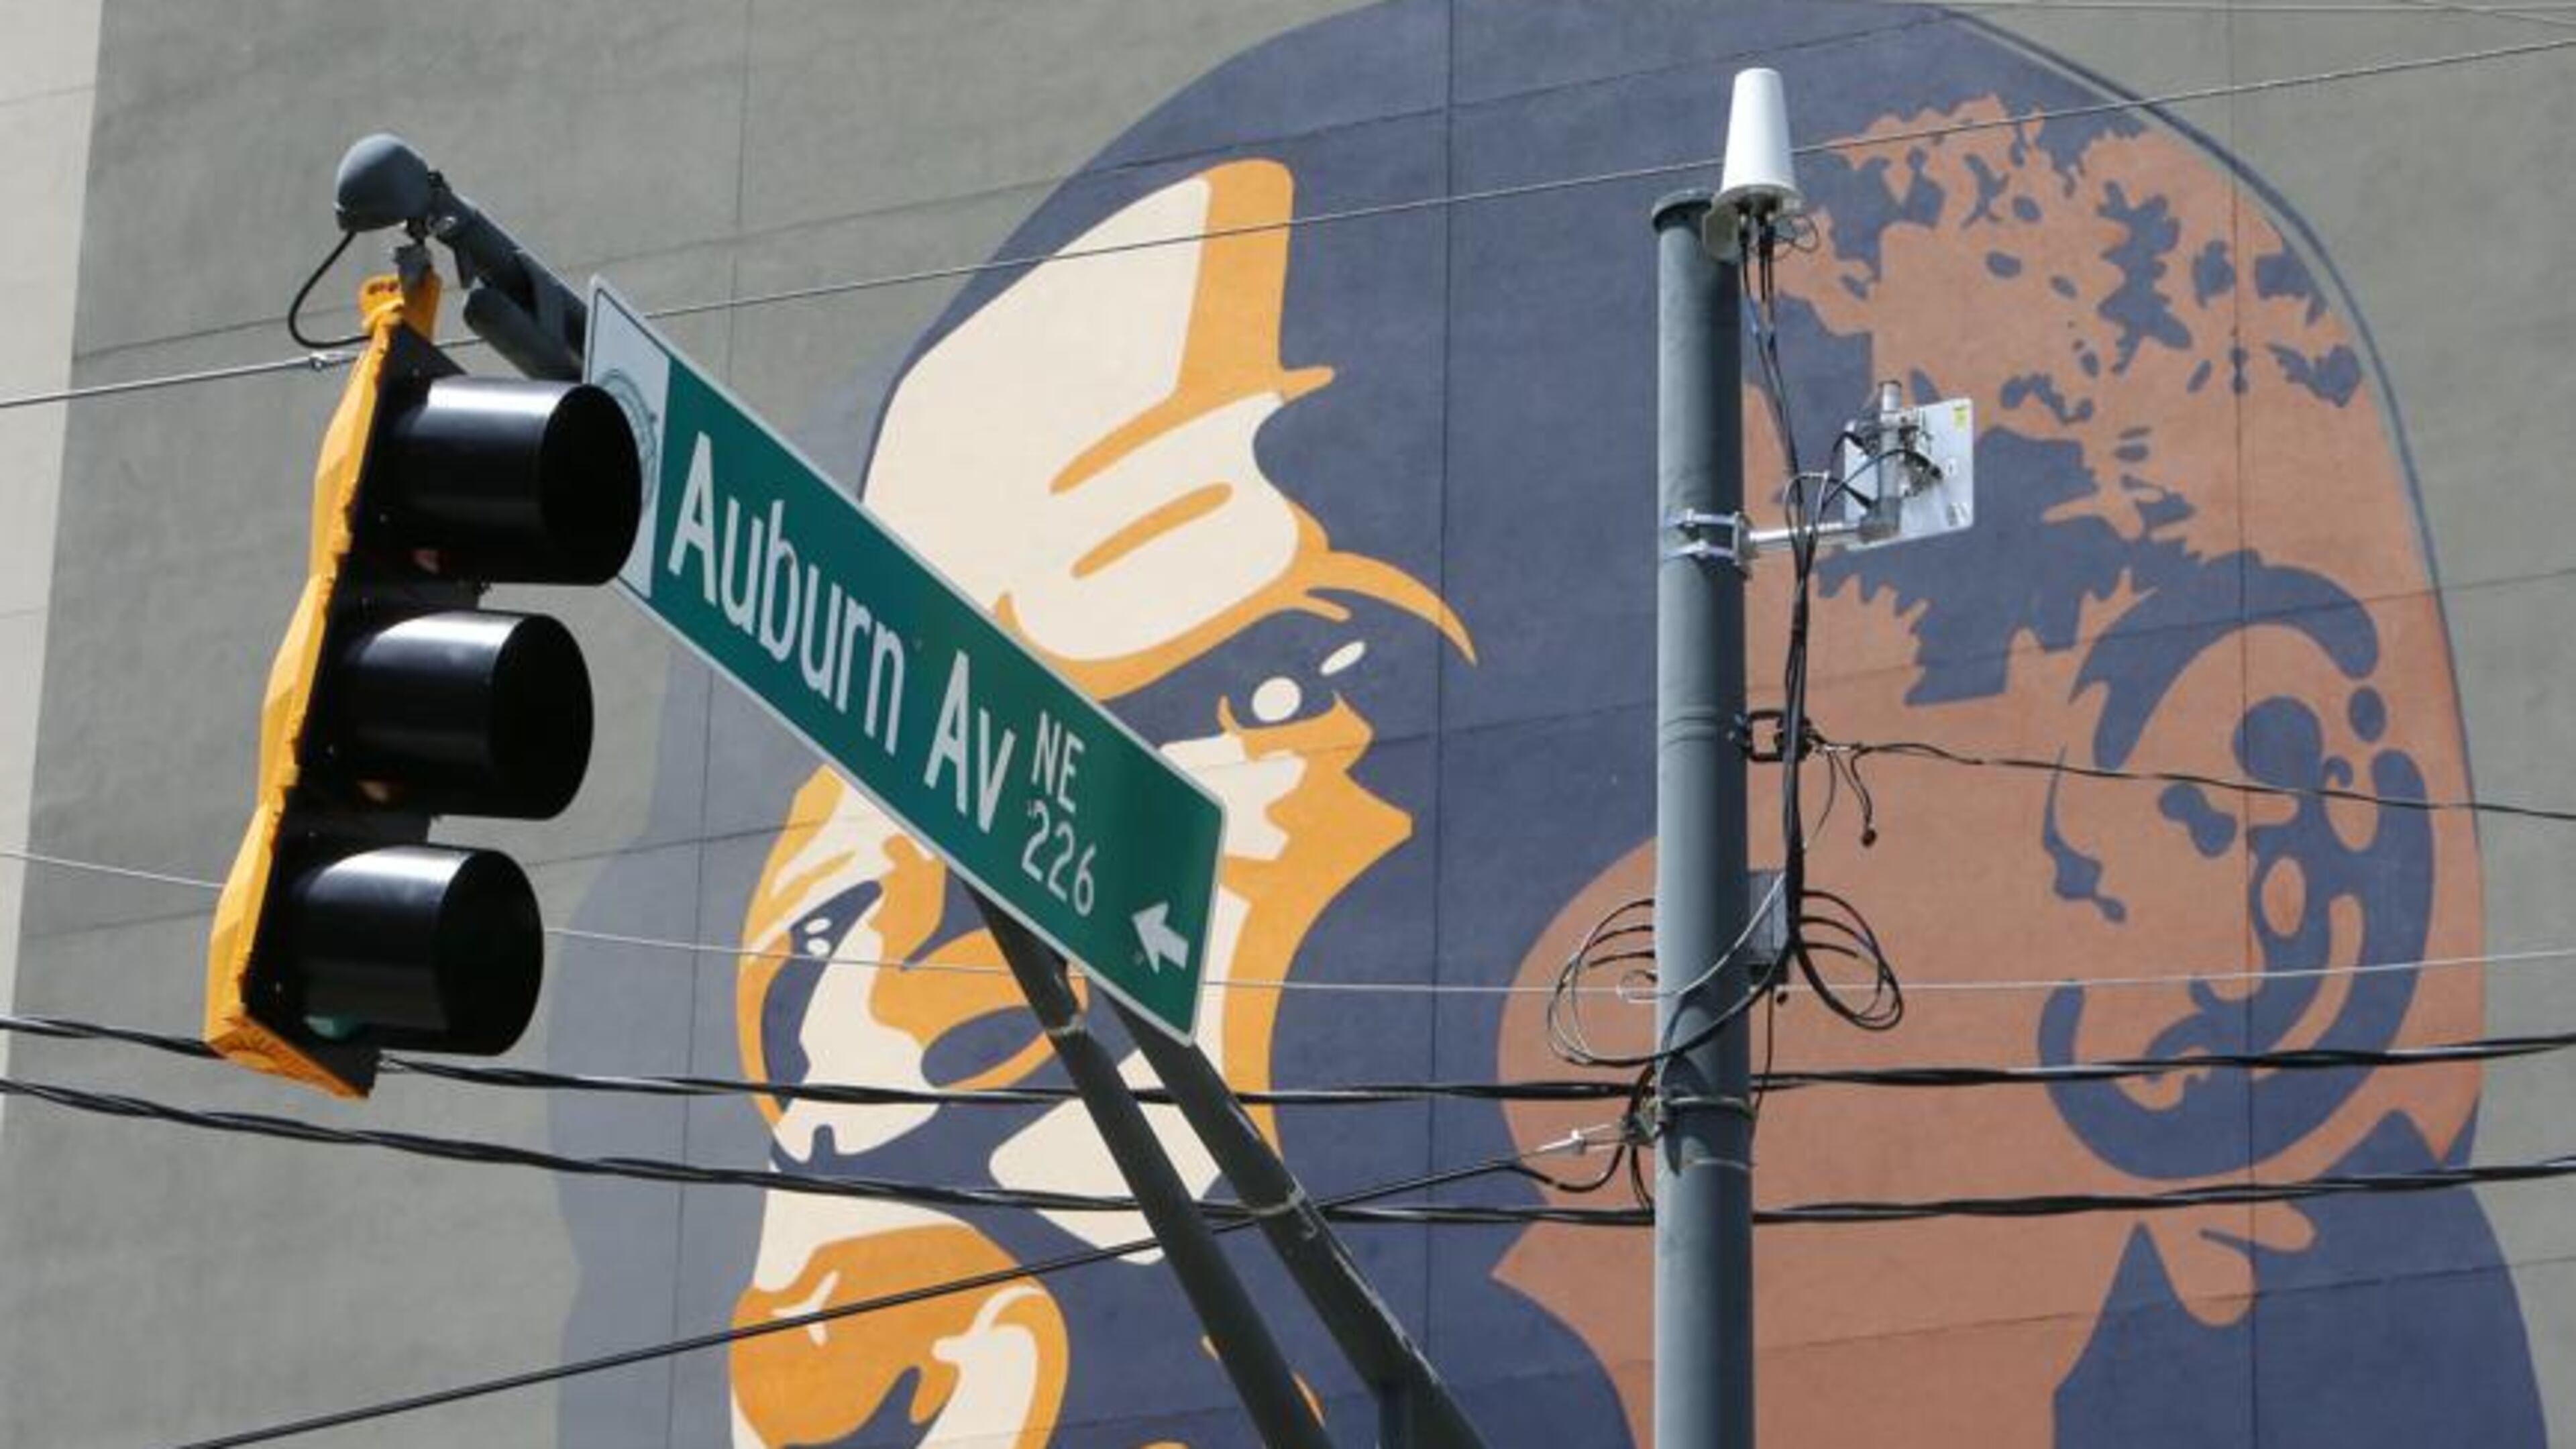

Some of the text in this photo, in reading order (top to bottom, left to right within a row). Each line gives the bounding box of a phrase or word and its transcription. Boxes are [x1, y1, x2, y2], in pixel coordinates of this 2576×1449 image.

[667, 431, 905, 755] Auburn
[924, 650, 1016, 833] Av
[1031, 710, 1085, 814] NE
[1022, 799, 1096, 917] 226
